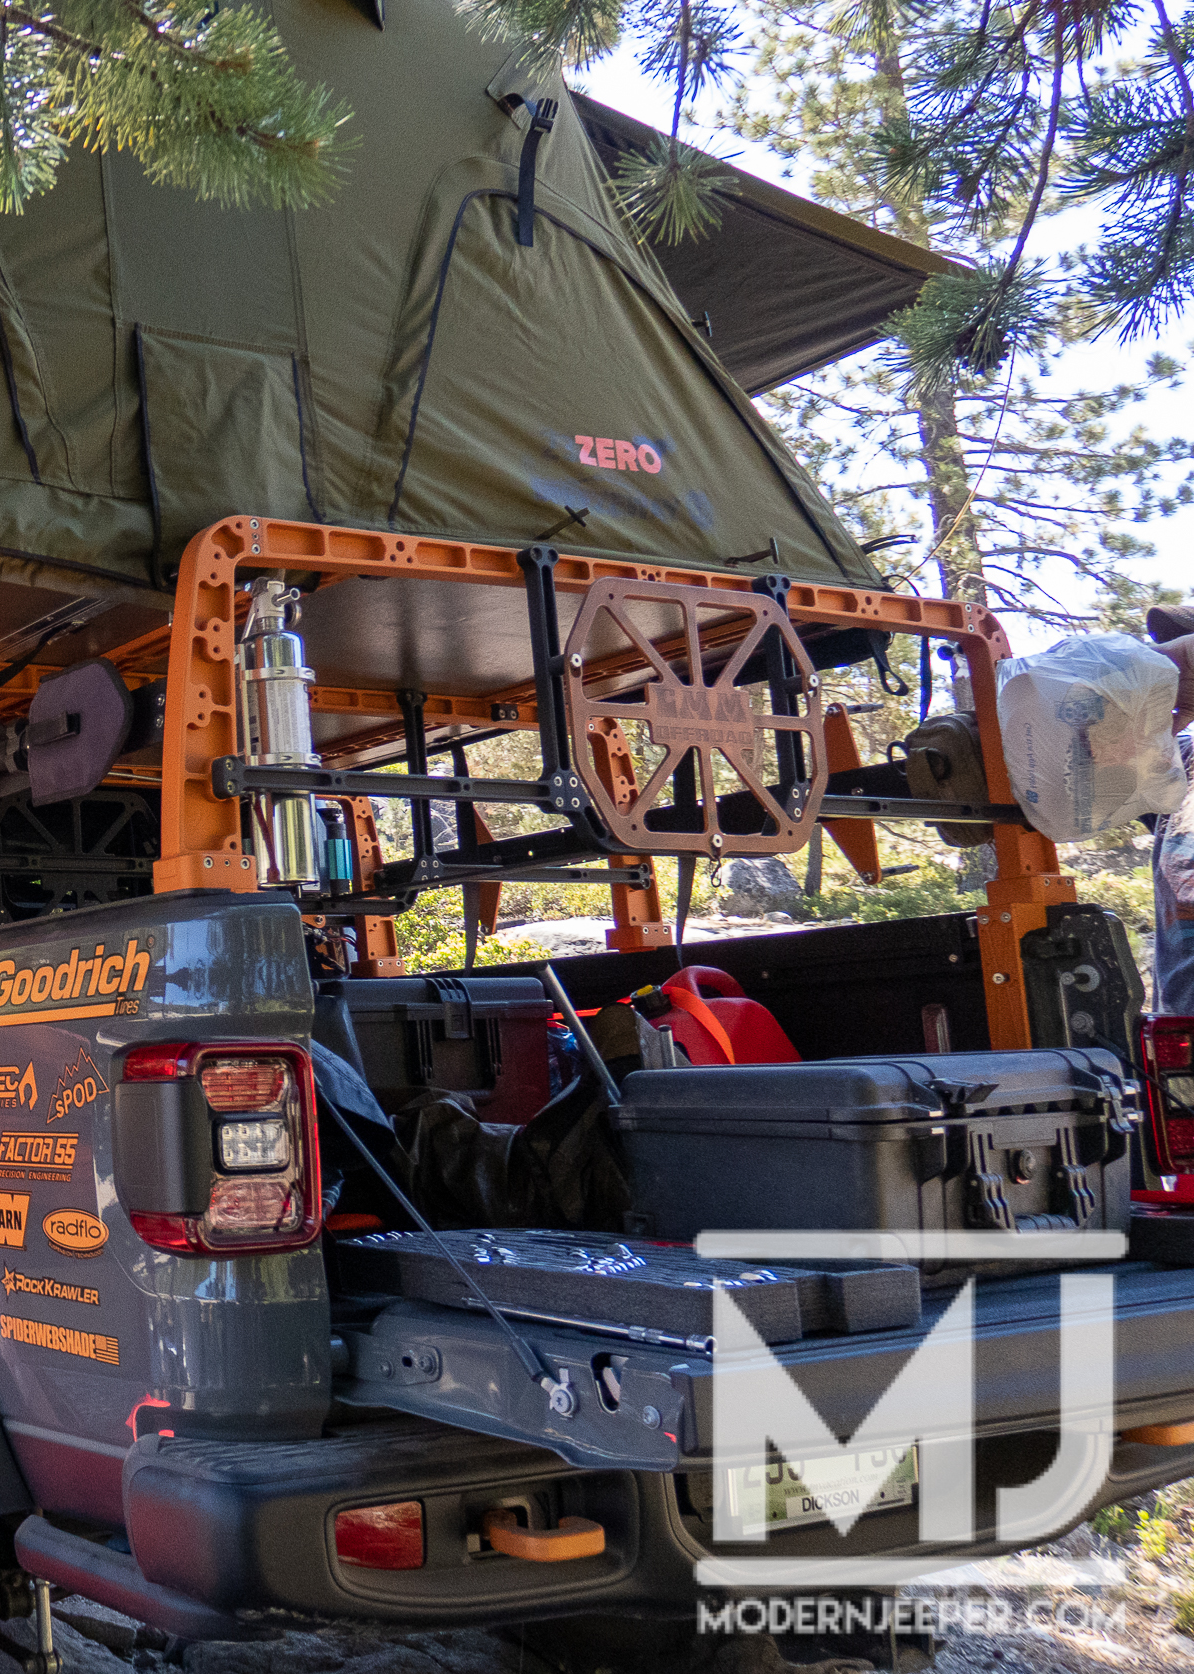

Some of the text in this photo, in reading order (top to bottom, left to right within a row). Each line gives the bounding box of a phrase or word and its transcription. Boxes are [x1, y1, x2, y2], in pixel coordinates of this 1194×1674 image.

[574, 434, 662, 475] ZERO
[116, 996, 140, 1016] Tires
[54, 1137, 79, 1165] 55
[28, 1170, 73, 1183] ENGINEERING
[49, 1218, 103, 1240] radflo
[0, 1313, 98, 1360] SPIDERWEBSHADE
[801, 1489, 860, 1513] DICKSON
